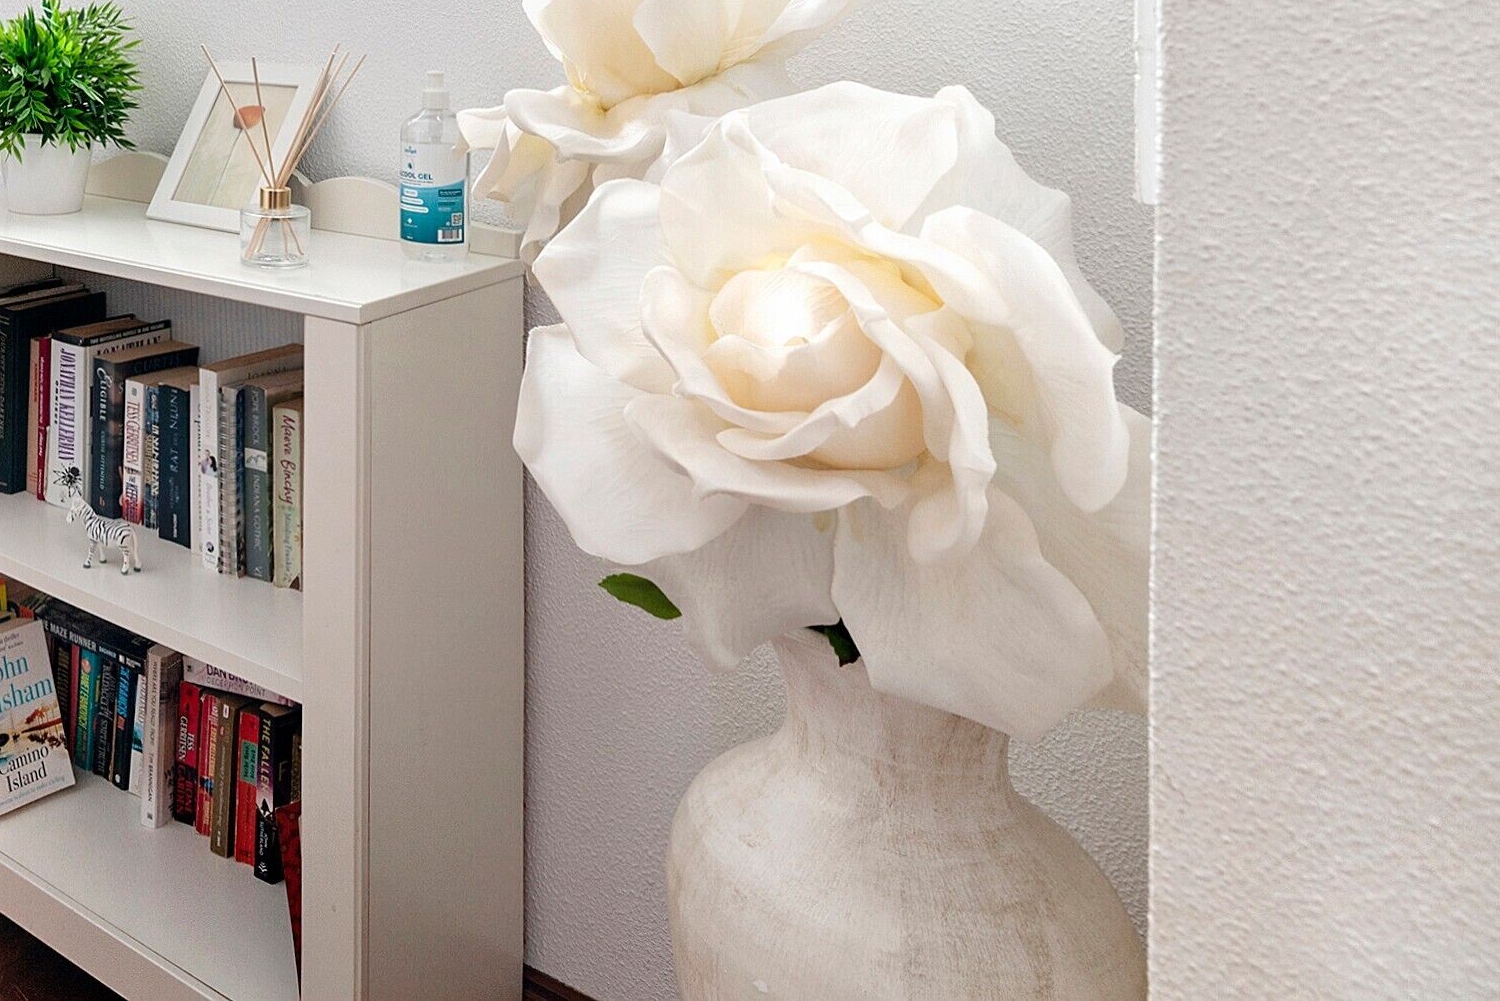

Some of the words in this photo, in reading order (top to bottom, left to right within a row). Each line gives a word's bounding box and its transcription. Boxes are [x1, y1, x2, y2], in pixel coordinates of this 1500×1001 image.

[59, 348, 76, 402] JONATHAN
[127, 401, 141, 420] TESS
[58, 403, 76, 461] KELLERMAN
[125, 419, 141, 466] GERRITSEN
[282, 415, 296, 456] Maeve
[279, 459, 297, 505] Binchy
[50, 623, 68, 639] MAZE
[69, 630, 98, 652] RUNNER
[206, 664, 227, 679] DAN
[245, 684, 266, 697] POINT
[117, 676, 130, 717] FRANCIS
[177, 716, 189, 761] GERRITSEN
[186, 731, 196, 751] TESS
[261, 718, 271, 741] THE
[6, 761, 48, 793] Island
[260, 744, 271, 793] FALLEN
[258, 821, 266, 856] SUTHERLAND
